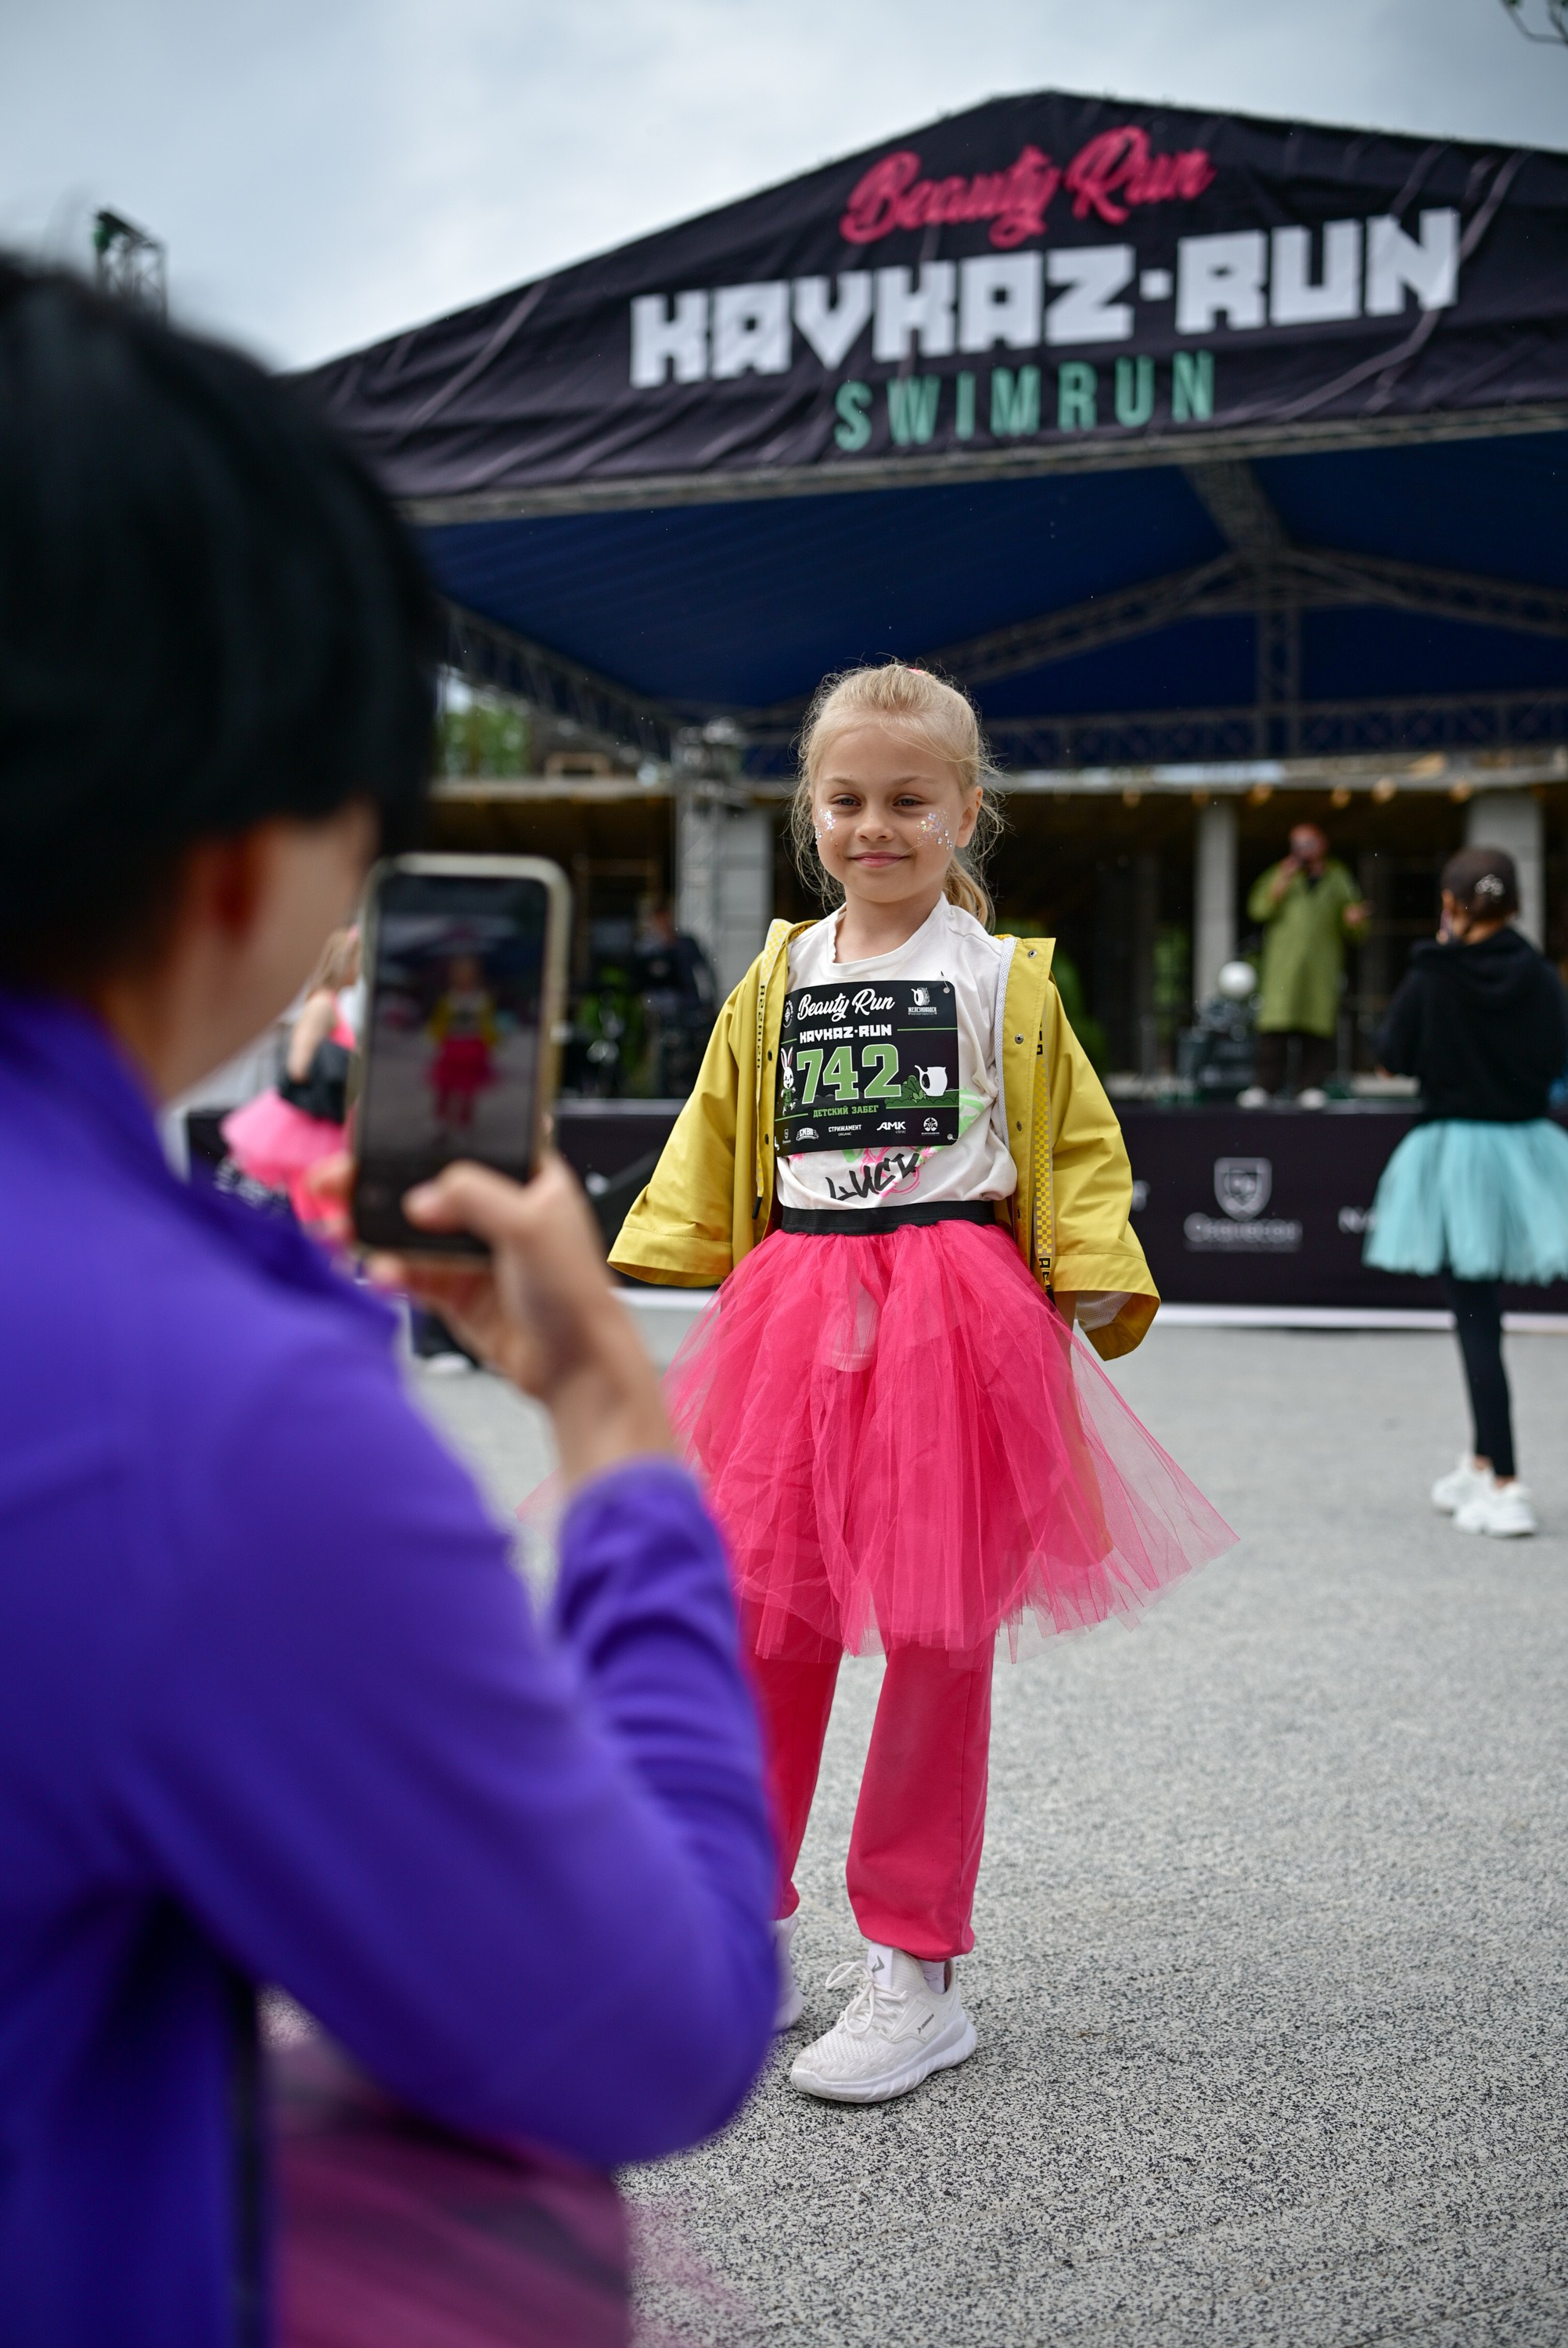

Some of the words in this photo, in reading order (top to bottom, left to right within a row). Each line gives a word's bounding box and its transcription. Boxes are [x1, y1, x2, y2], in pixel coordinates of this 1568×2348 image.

[840, 145, 1061, 247] Beauty
[1066, 124, 1217, 225] Run
[834, 349, 1216, 452] SWIMRUN
[797, 993, 851, 1022] Beauty
[851, 988, 895, 1016] Run
[796, 1043, 901, 1105] 742
[813, 1105, 849, 1118] ДЕТСКИЙ
[851, 1104, 879, 1114] ЗАБЕГ
[828, 1124, 862, 1133] СТРИЖАМЕНТ
